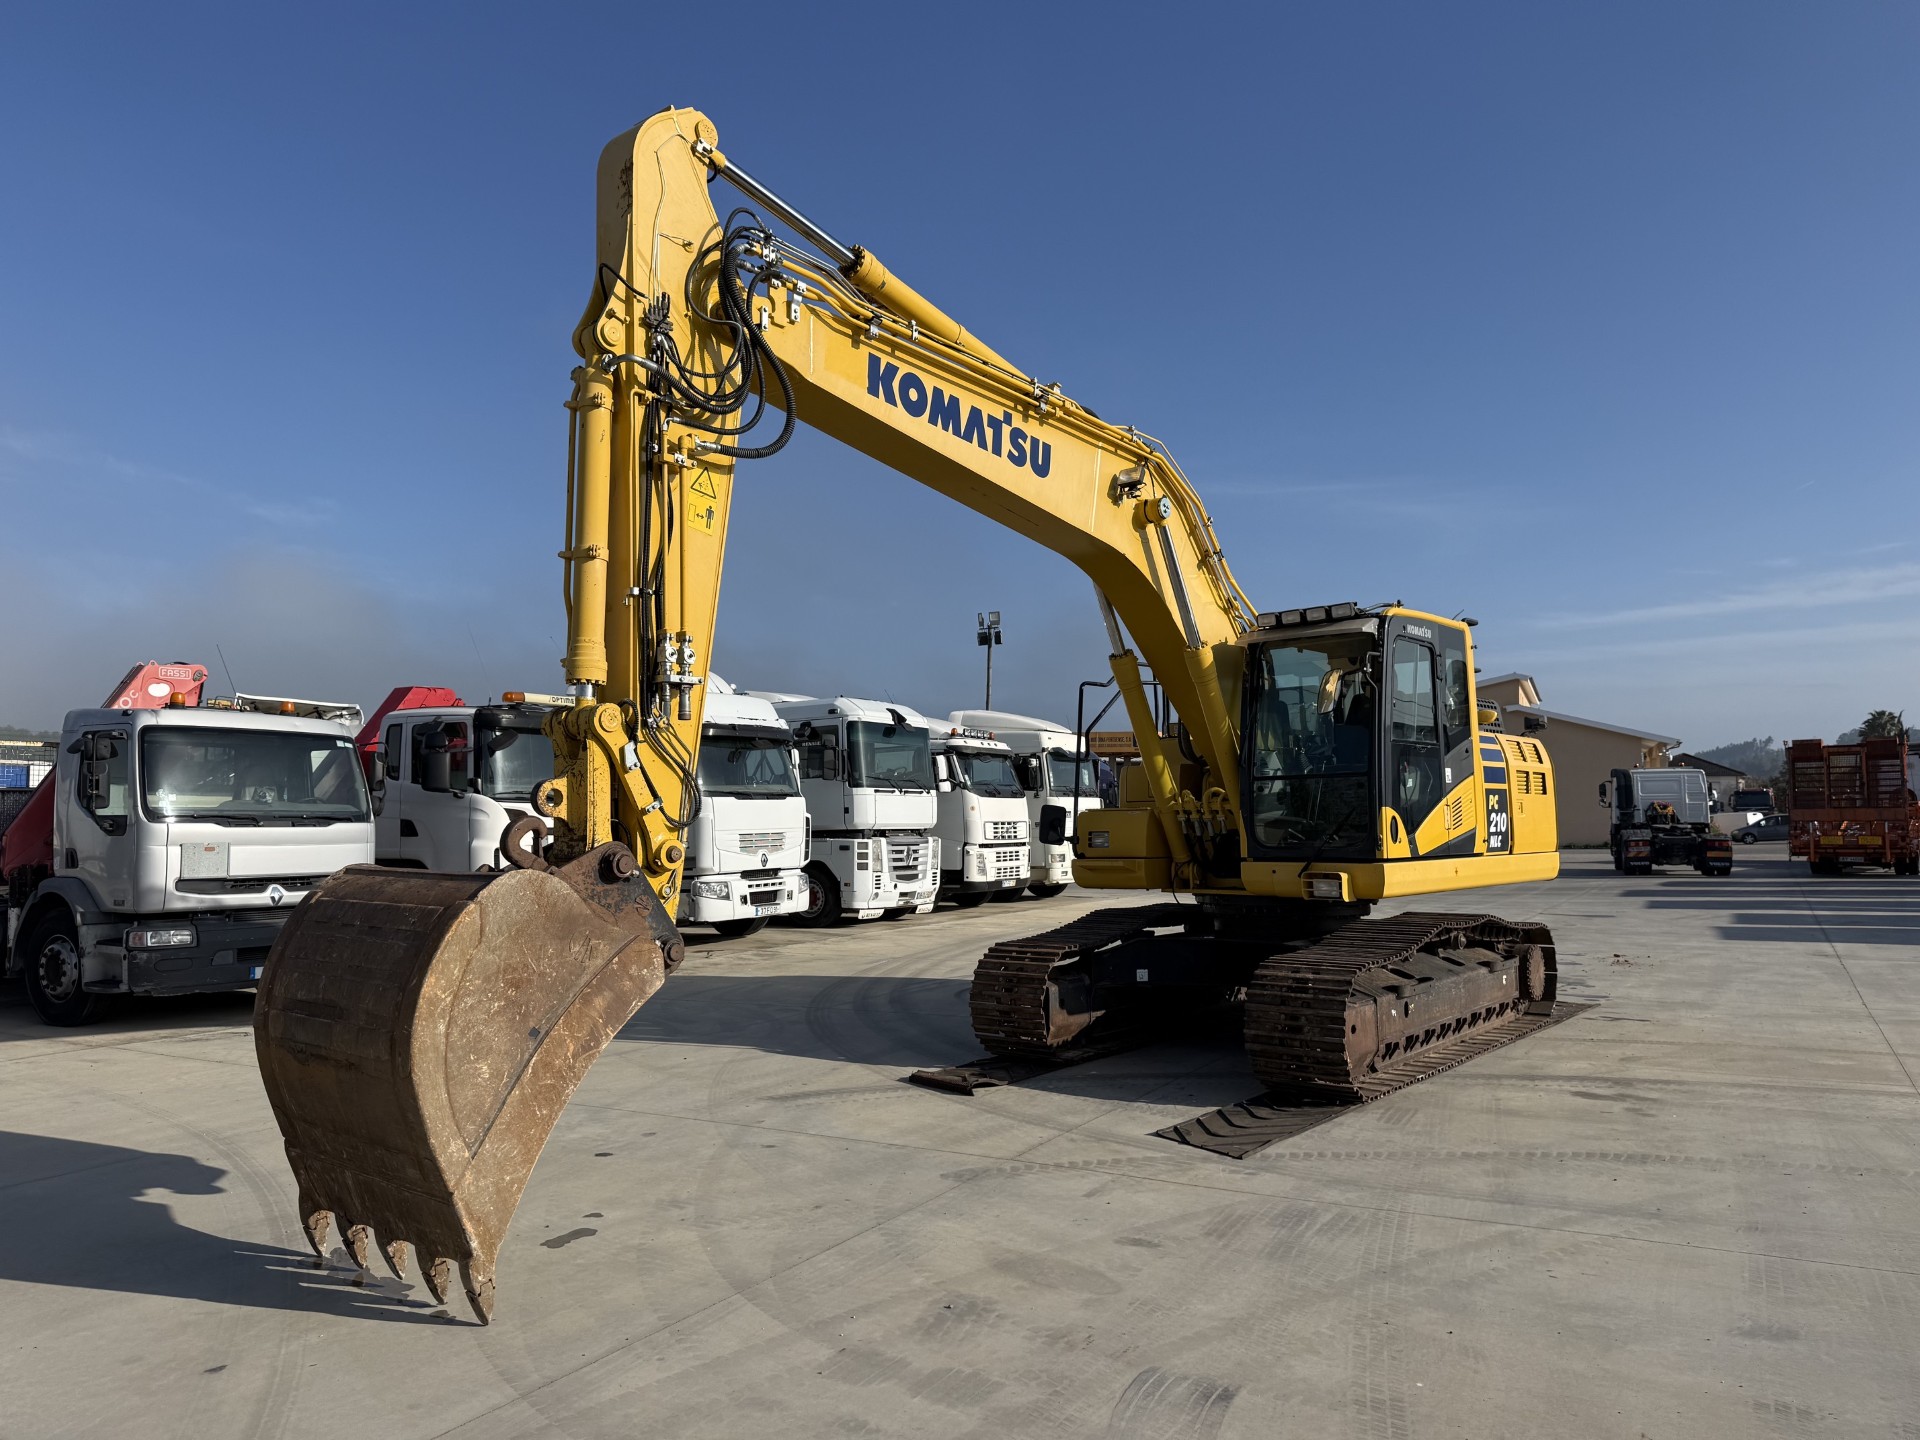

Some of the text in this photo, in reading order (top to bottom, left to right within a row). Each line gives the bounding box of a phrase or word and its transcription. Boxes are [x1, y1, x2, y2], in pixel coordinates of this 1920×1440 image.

[867, 352, 1052, 479] KOMATSU
[1406, 623, 1432, 639] KOMATSU
[161, 669, 190, 678] FASSI
[1489, 794, 1499, 810] PC
[1489, 812, 1507, 833] 210
[1490, 834, 1502, 848] NLC
